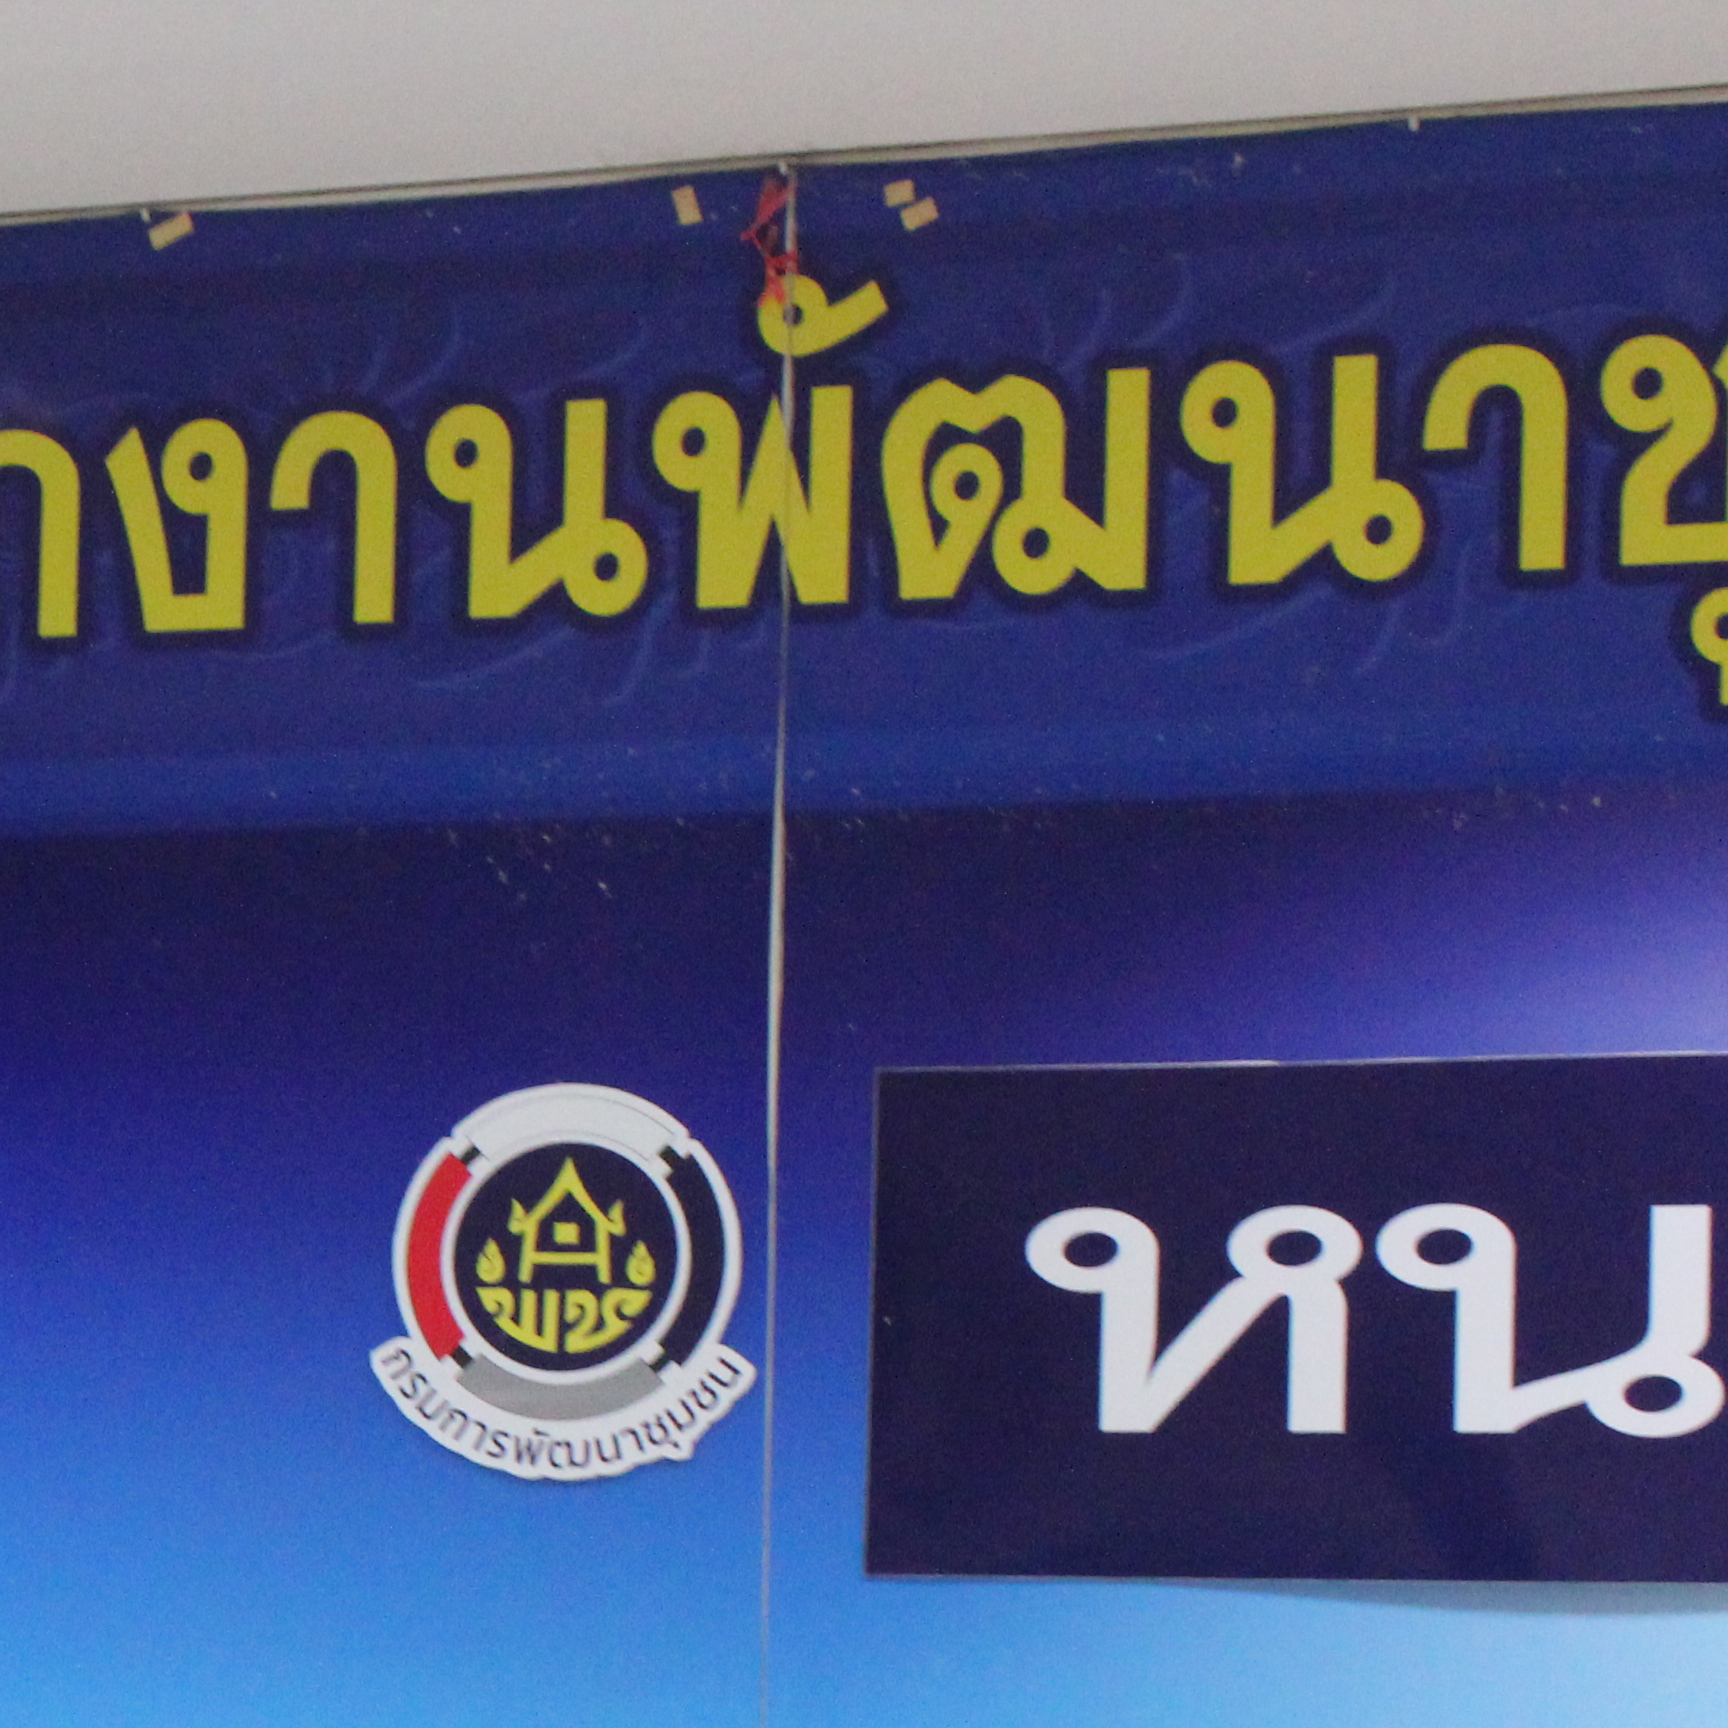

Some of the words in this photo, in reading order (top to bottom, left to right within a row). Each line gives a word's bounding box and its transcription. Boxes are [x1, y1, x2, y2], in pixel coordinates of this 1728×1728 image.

[382, 1348, 744, 1468] กรมการพัฒนาชุมชน
